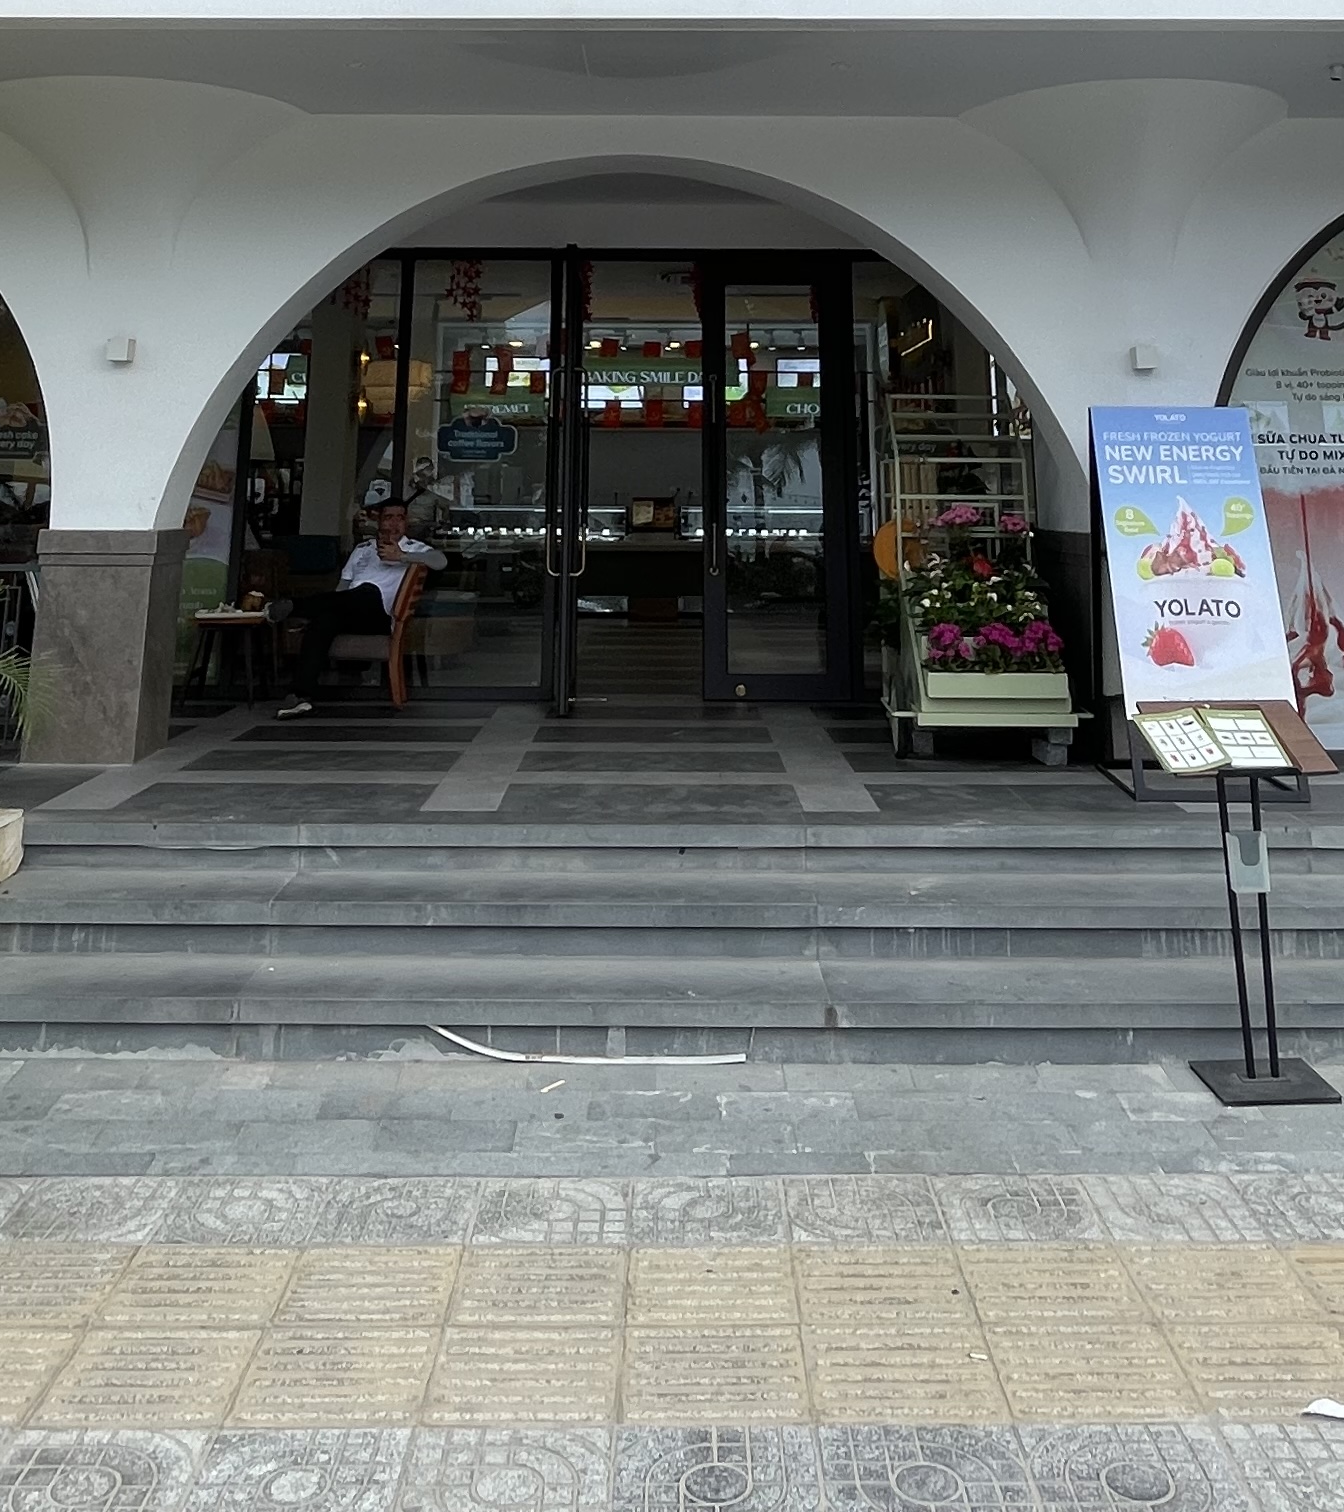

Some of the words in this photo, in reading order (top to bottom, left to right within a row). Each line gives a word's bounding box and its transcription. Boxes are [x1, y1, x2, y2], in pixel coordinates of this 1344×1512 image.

[640, 371, 684, 384] SMILE
[1154, 413, 1187, 422] YOLATO
[1103, 432, 1141, 442] FRESH
[1144, 432, 1190, 442] FROZEN
[1192, 432, 1241, 442] YOGURT
[1258, 431, 1285, 444] SỮA
[1289, 433, 1327, 444] CHUA
[1105, 445, 1153, 461] NEW
[1159, 445, 1244, 462] ENERGY
[1277, 449, 1295, 463] TỰ
[1299, 450, 1318, 460] DO
[1108, 465, 1188, 485] SWIRL
[1153, 598, 1241, 619] YOLATO
